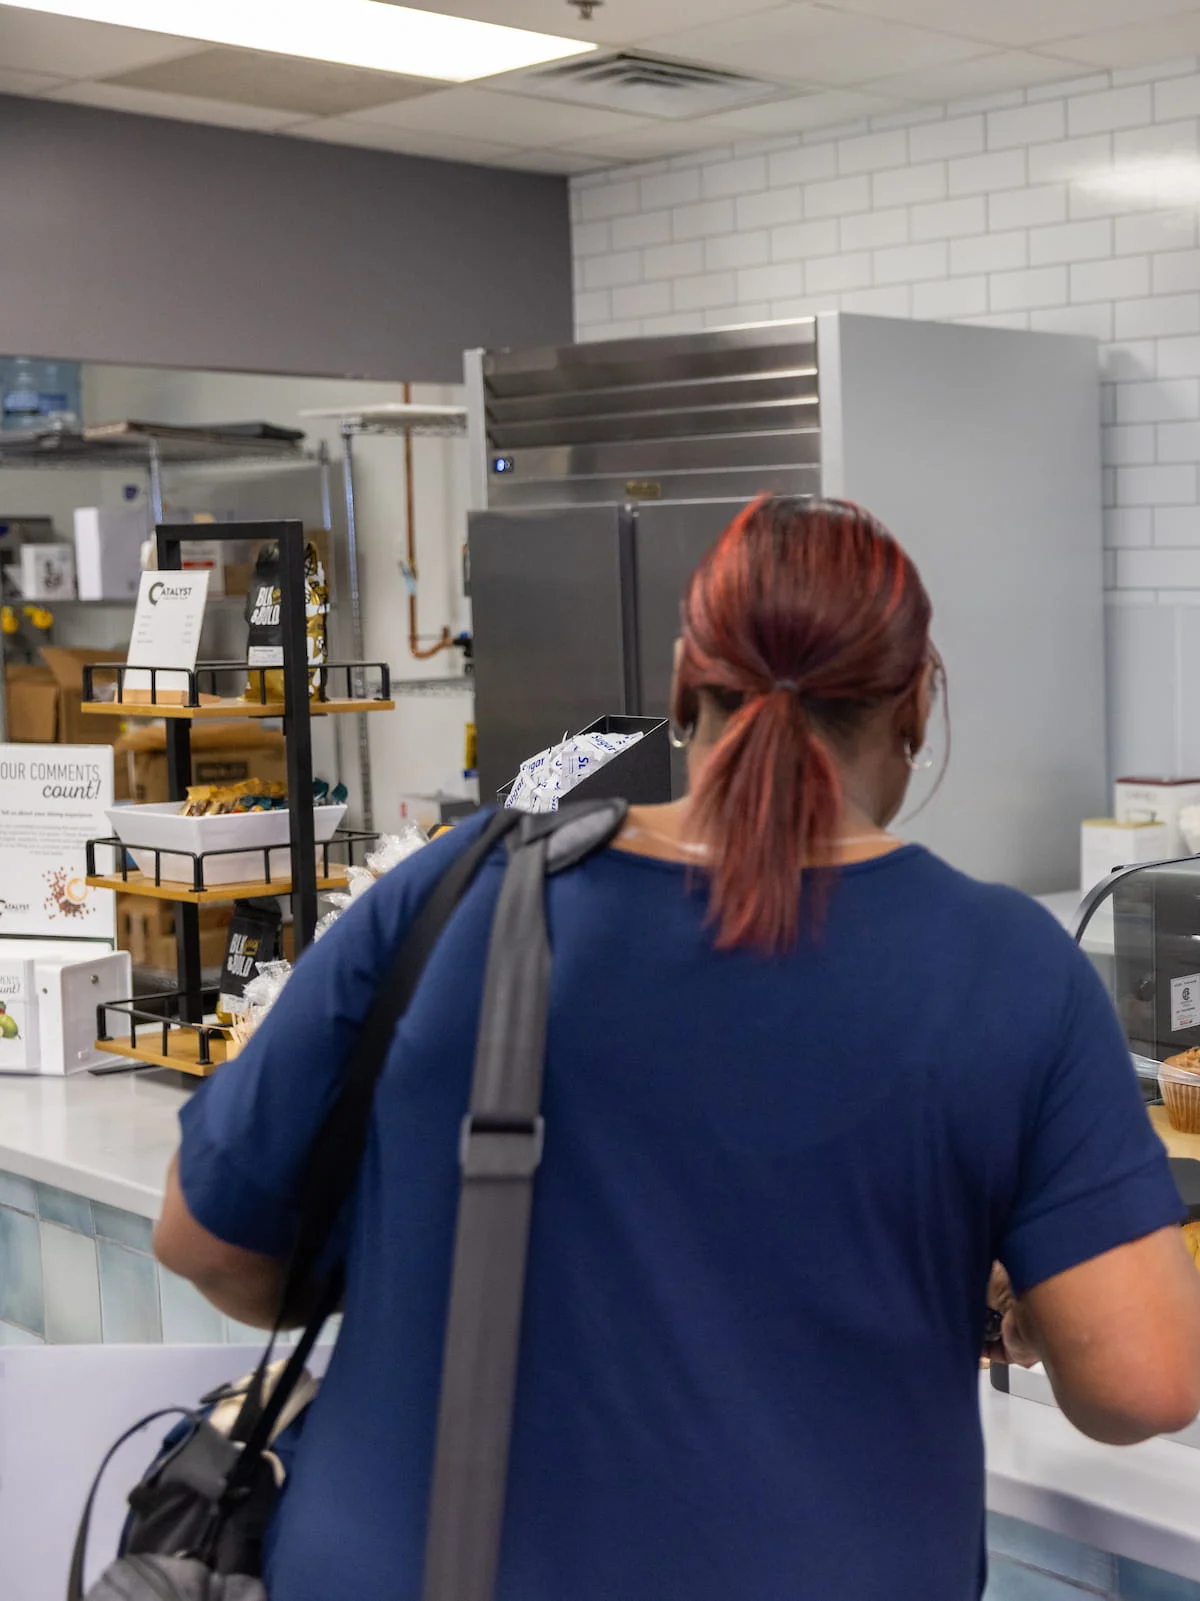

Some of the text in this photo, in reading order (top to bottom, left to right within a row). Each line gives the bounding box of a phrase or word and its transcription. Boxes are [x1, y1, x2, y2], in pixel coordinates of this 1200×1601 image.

[148, 581, 193, 606] CATALYST
[30, 763, 100, 783] COMMENTS
[42, 780, 102, 800] count!
[0, 899, 30, 917] ATALYST
